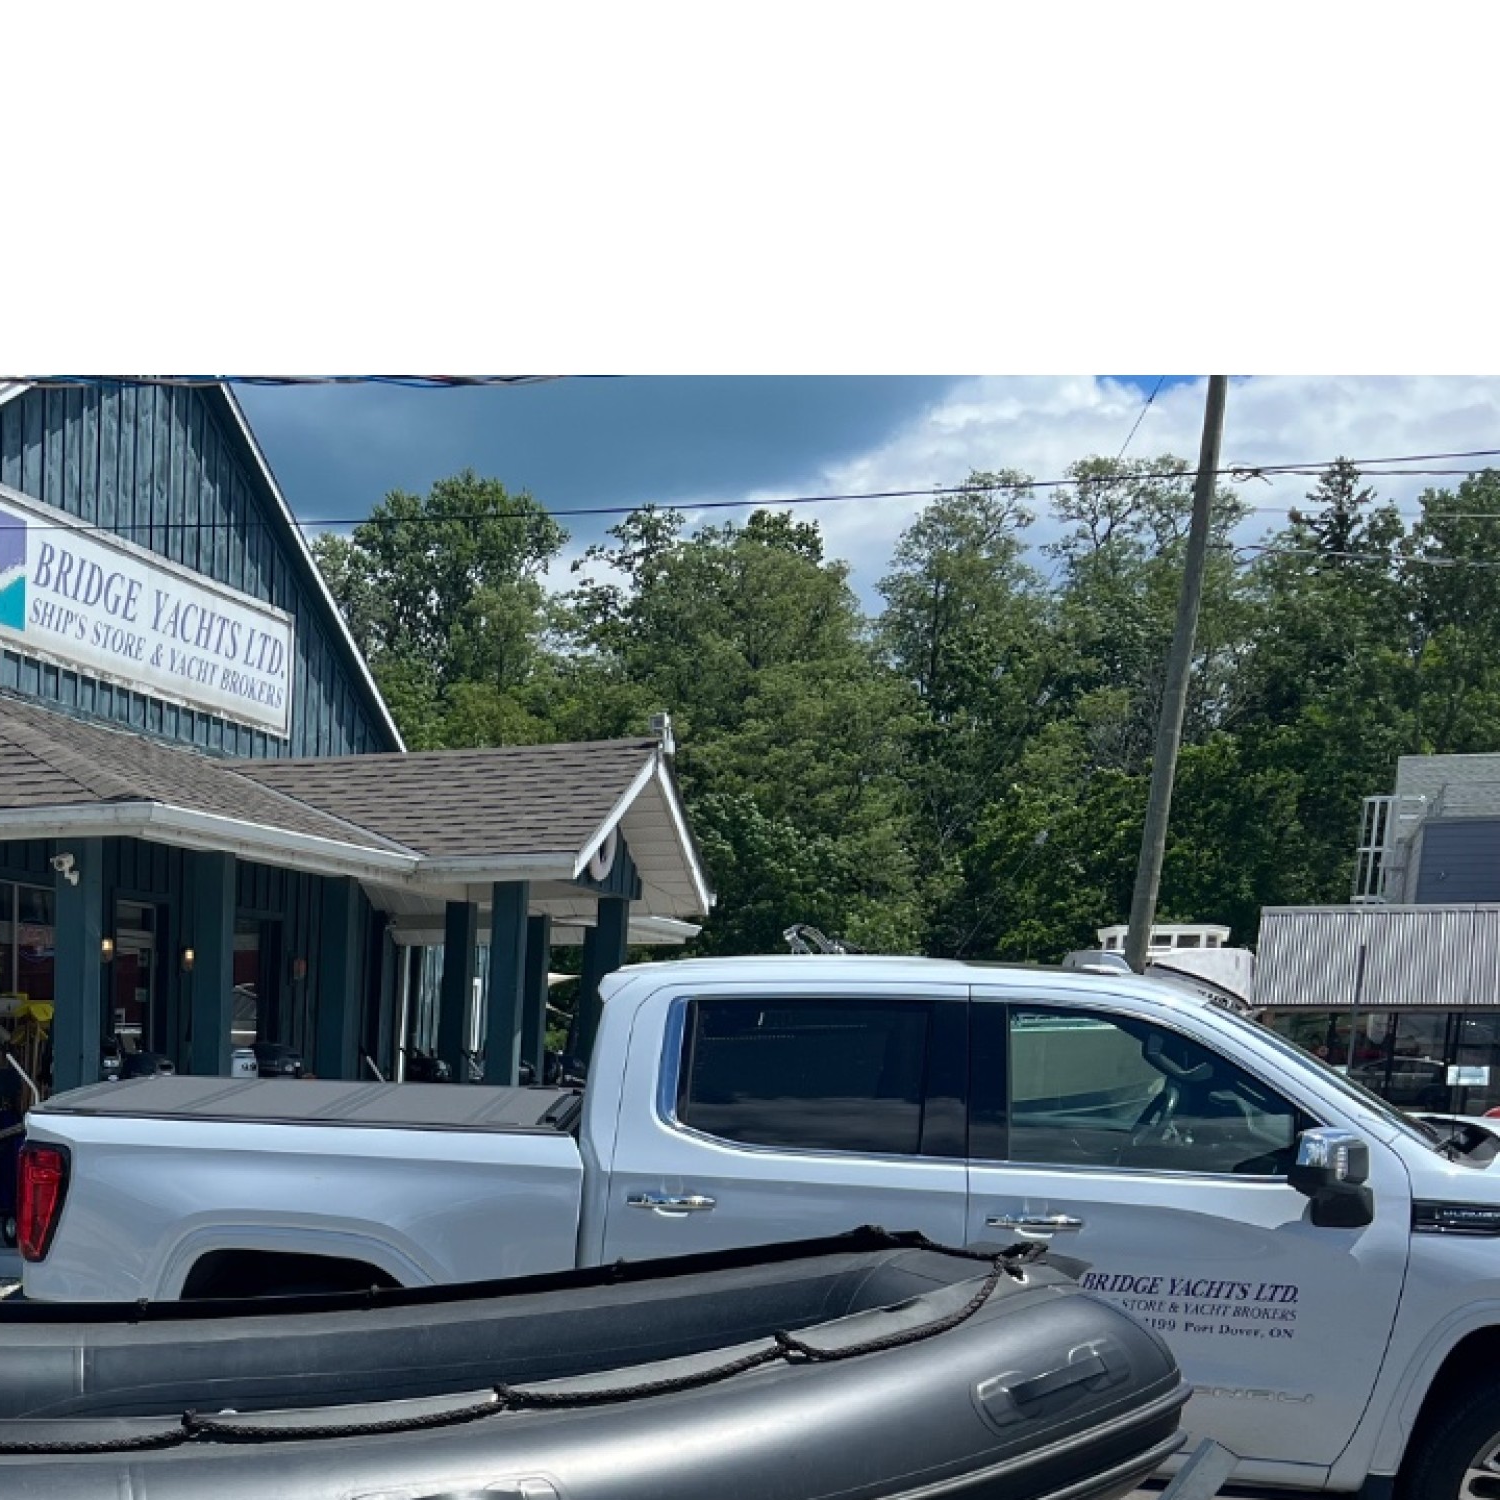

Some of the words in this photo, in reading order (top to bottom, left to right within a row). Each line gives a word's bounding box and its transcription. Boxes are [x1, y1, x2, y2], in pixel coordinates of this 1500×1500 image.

[32, 541, 143, 623] BRIDGE
[151, 589, 244, 660] YACHTS
[241, 627, 286, 680] LTD.
[29, 597, 87, 641] SHIP'S
[90, 620, 147, 662] STORE
[150, 642, 165, 668] &
[168, 647, 220, 686] YACHT
[220, 667, 284, 709] BROKERS
[1082, 1271, 1164, 1295] BRIDGE
[1168, 1276, 1252, 1300] YACHTS
[1253, 1282, 1299, 1304] LTD.
[1121, 1298, 1165, 1312] STORE
[1168, 1300, 1180, 1313] &
[1184, 1302, 1233, 1318] YACHT
[1232, 1305, 1298, 1322] BROKERS
[1145, 1317, 1176, 1331] 199
[1184, 1321, 1214, 1335] Port
[1268, 1326, 1296, 1339] ON
